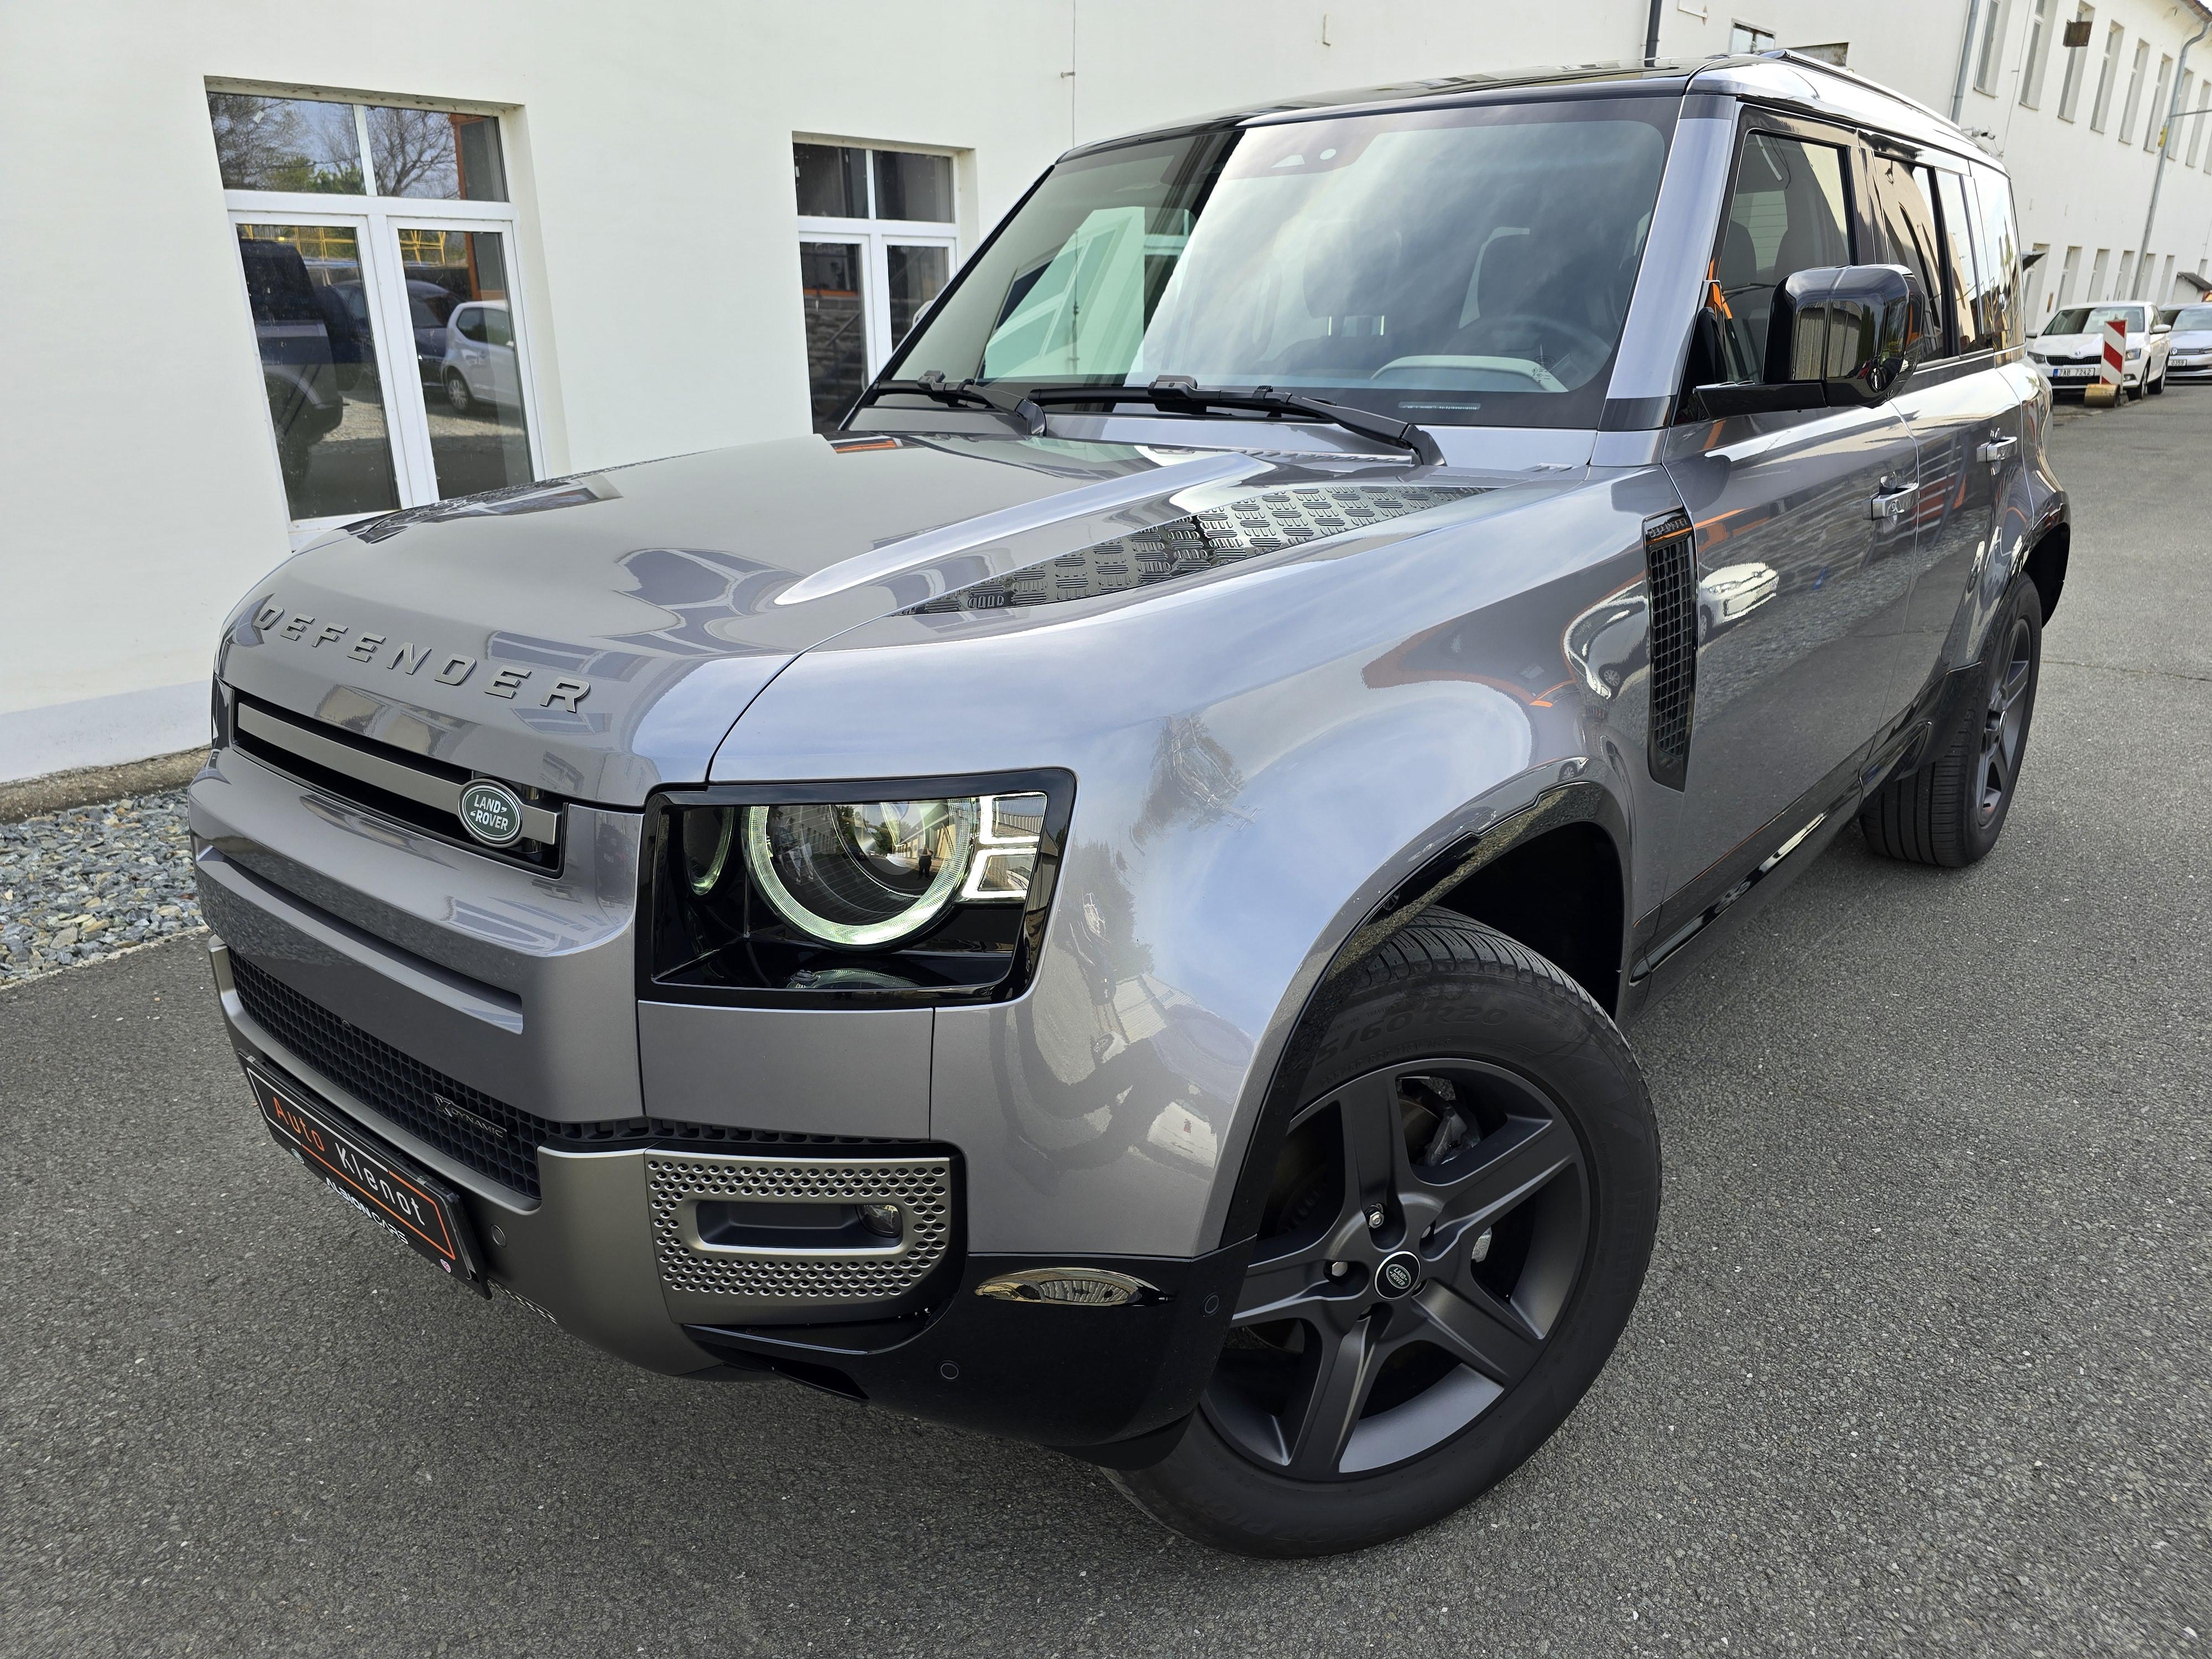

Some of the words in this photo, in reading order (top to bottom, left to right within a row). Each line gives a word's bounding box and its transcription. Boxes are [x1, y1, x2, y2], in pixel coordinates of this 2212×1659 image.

[253, 604, 591, 713] DEFENDER
[474, 795, 501, 813] LAND
[475, 809, 508, 831] ROVER
[1421, 1004, 1509, 1026] R20
[451, 1107, 503, 1138] DYNAMIC
[273, 1097, 325, 1152] Auto
[335, 1142, 425, 1225] Klenot
[1390, 1272, 1406, 1286] ROVER
[1393, 1267, 1406, 1279] LAND
